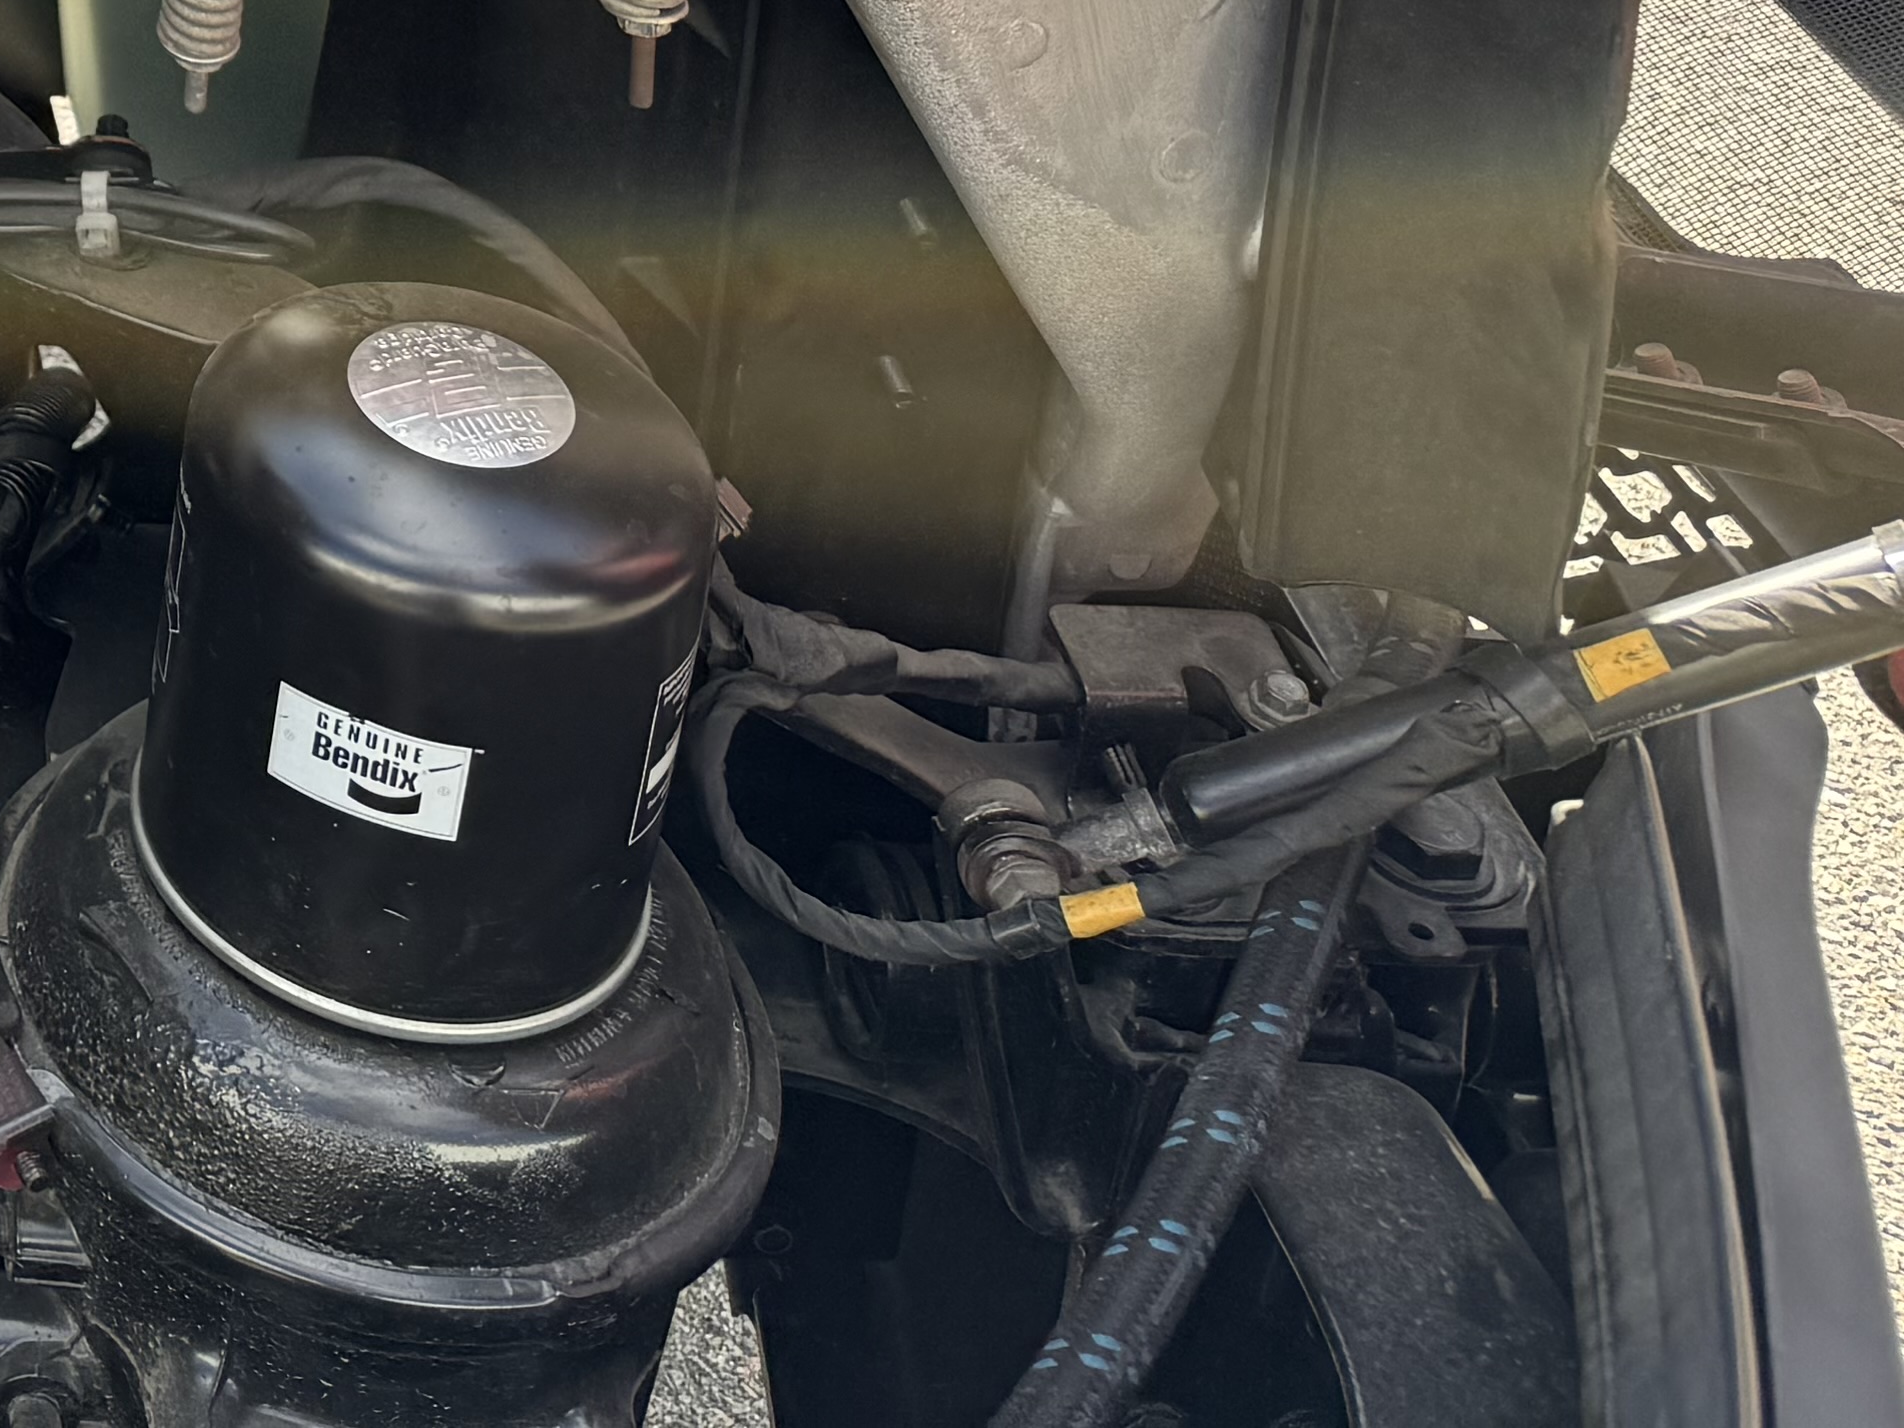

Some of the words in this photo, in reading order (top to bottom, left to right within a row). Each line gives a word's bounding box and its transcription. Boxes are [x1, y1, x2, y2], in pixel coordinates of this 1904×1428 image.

[463, 435, 546, 460] GENUINE
[311, 732, 420, 793] Bendix
[316, 711, 424, 765] GENUINE
